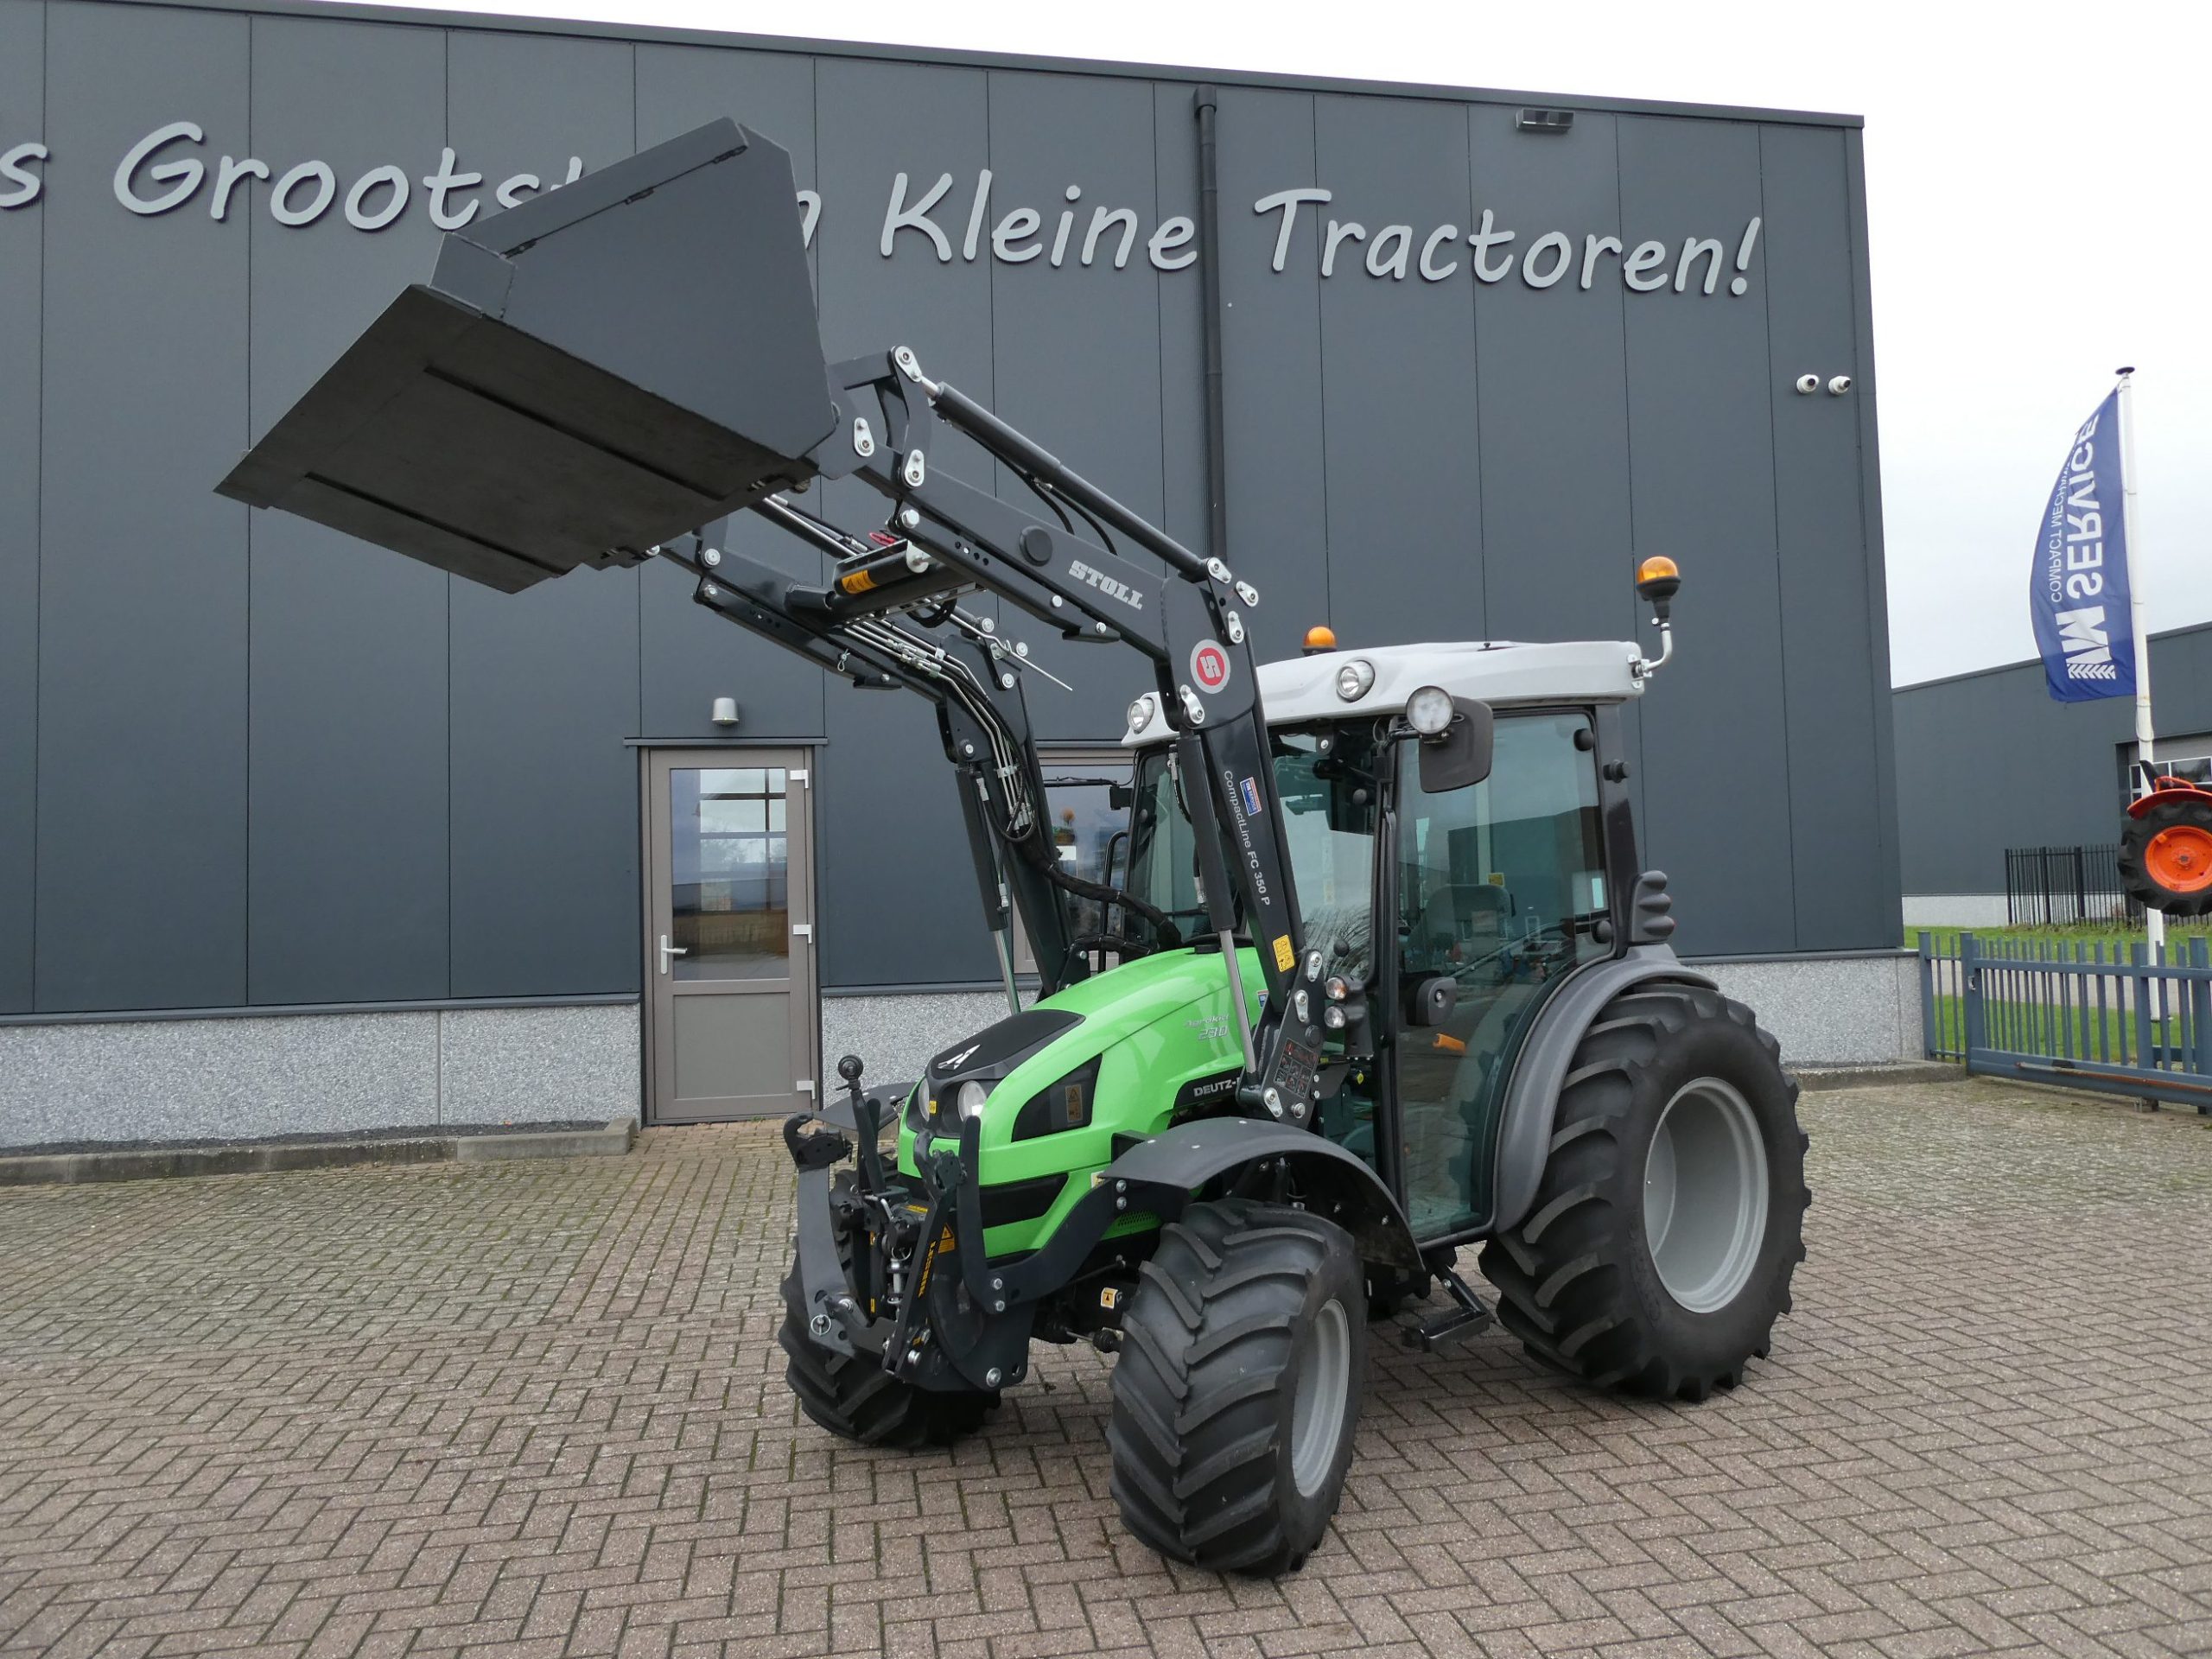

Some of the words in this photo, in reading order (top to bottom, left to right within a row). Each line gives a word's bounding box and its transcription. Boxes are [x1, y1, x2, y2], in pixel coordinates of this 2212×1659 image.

[880, 169, 1198, 270] Kleine
[1254, 188, 1762, 296] Tractoren!
[1068, 559, 1143, 610] STOLL
[1224, 770, 1252, 848] CompactLine
[1247, 850, 1260, 869] FC
[1254, 871, 1267, 893] 350
[1261, 896, 1271, 906] P
[1193, 1077, 1239, 1096] DEUTZ-
